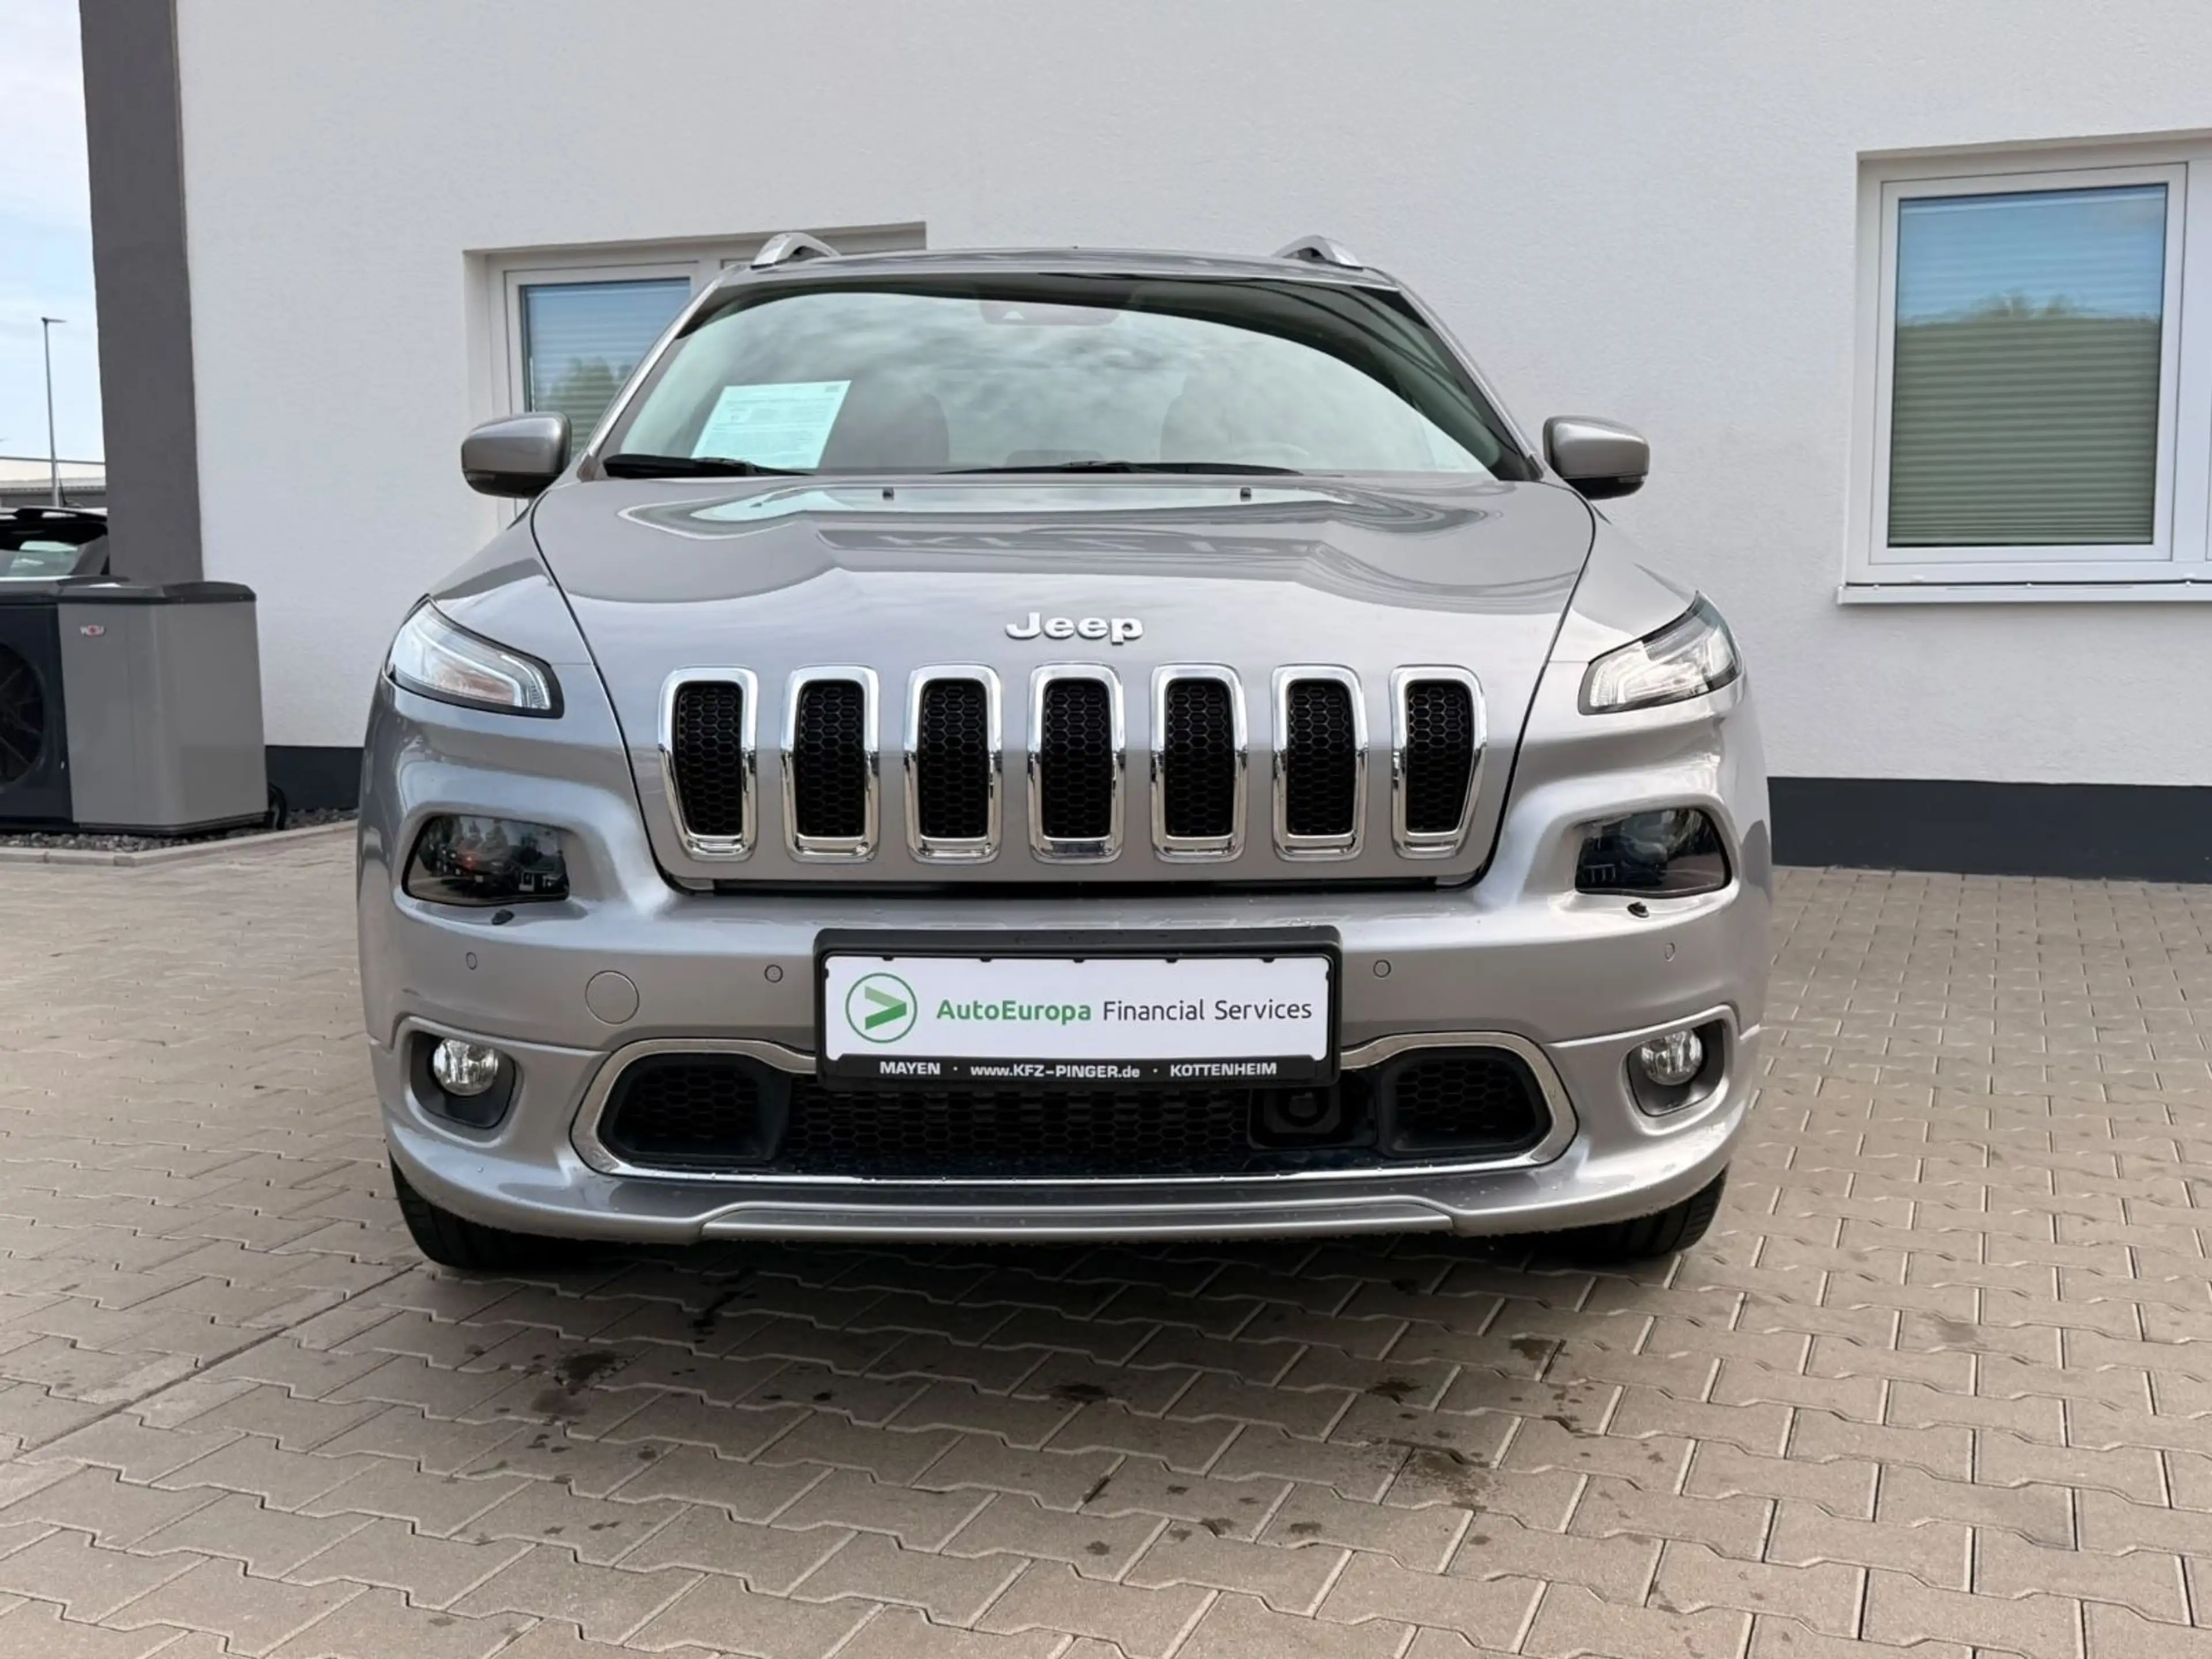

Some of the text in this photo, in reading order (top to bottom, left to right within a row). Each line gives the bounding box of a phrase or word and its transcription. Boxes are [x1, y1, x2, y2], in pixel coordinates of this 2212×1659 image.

[79, 625, 105, 637] WO
[1006, 612, 1143, 645] Jeep
[937, 999, 1313, 1025] AutoEuropa Financial Services
[879, 1061, 1278, 1078] MAYEN www.KFZ-PINGER.de KOTTENHEIM
